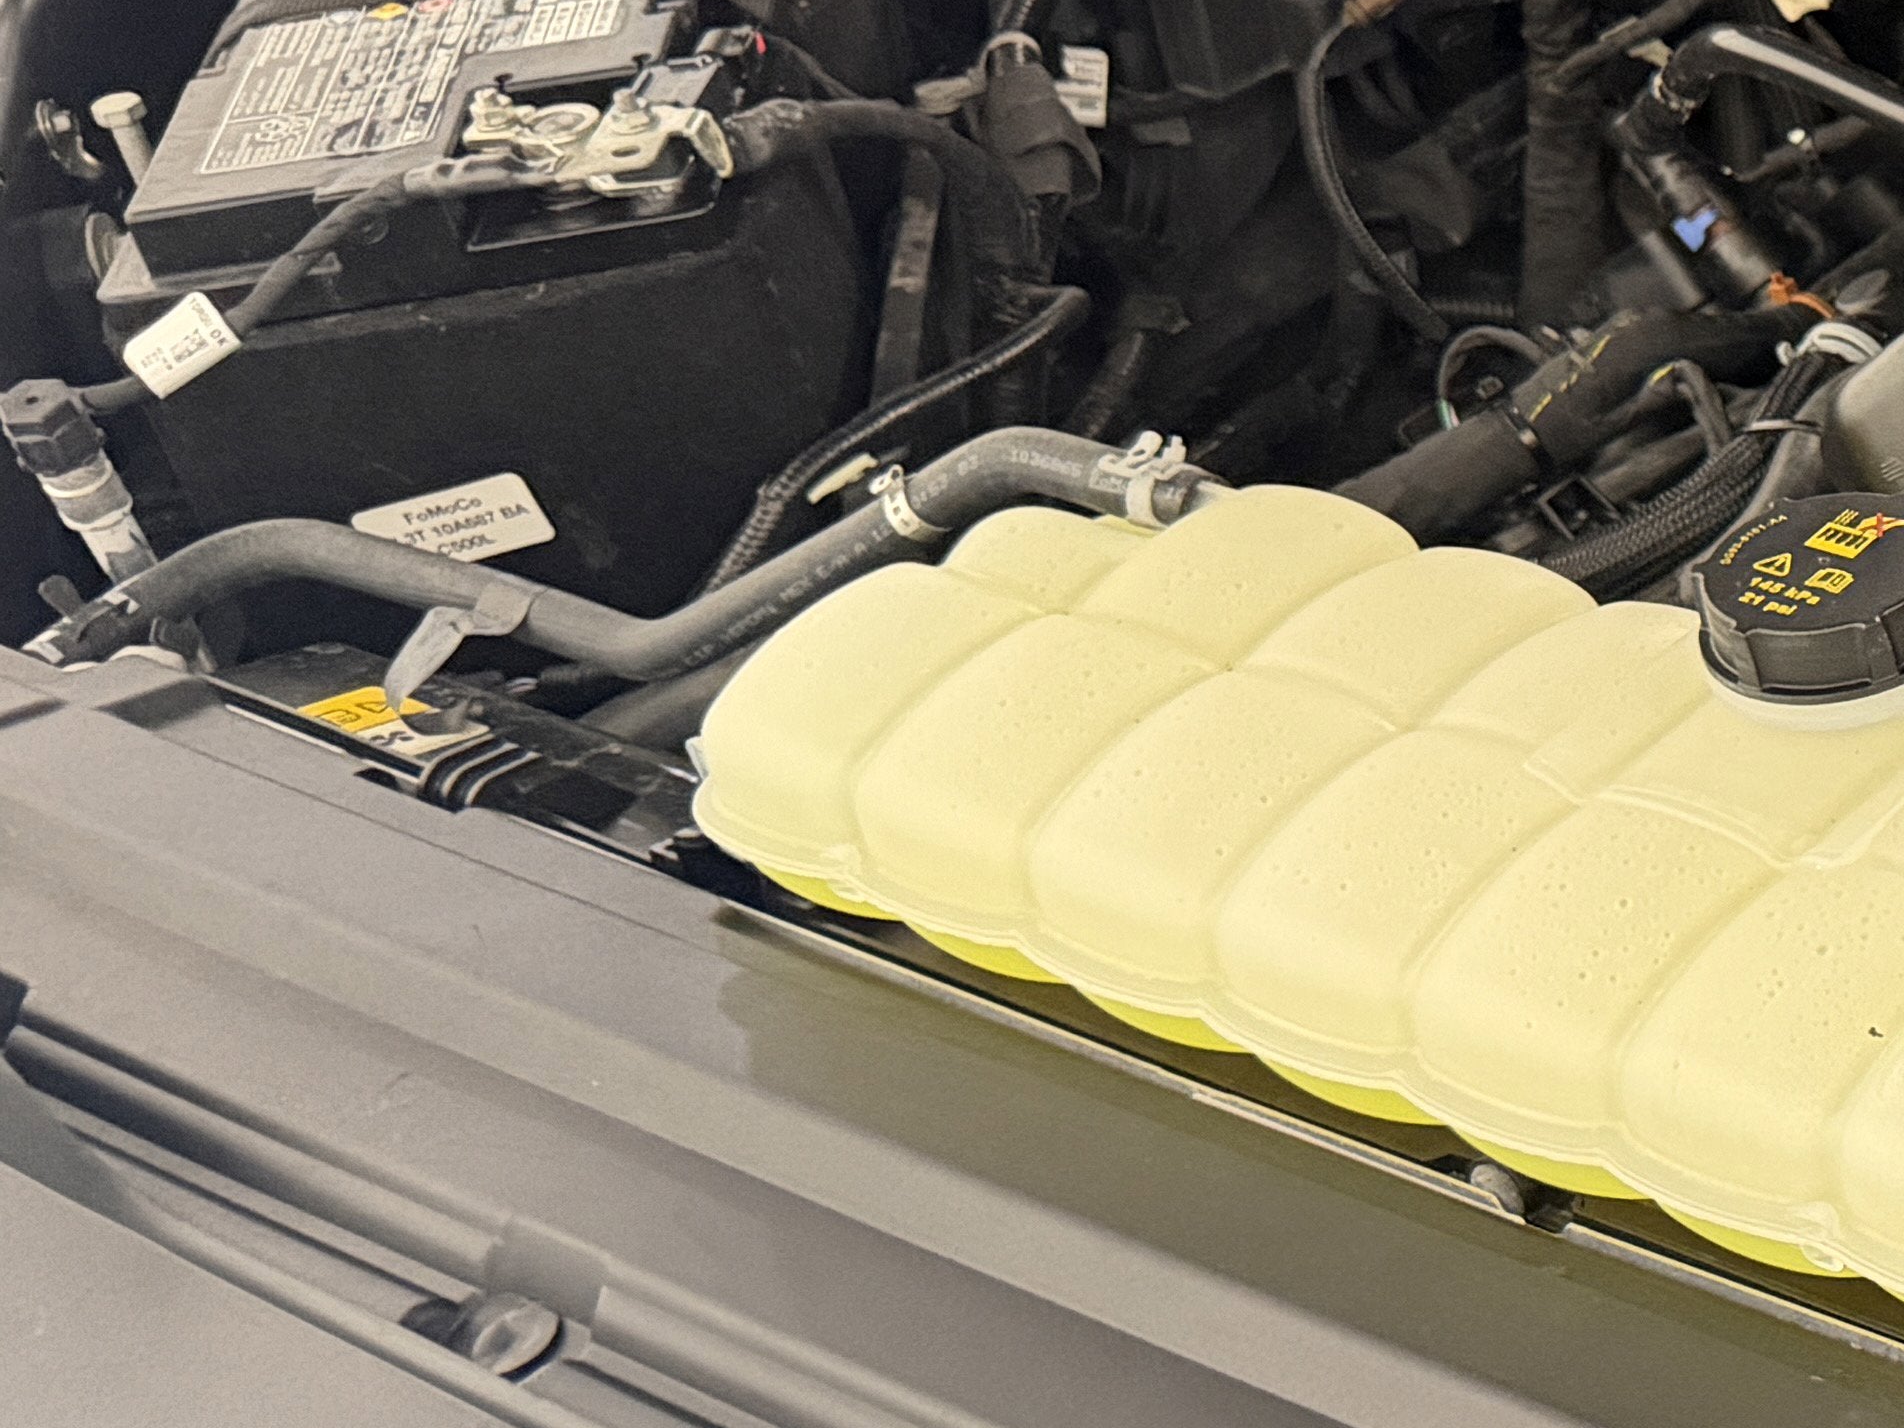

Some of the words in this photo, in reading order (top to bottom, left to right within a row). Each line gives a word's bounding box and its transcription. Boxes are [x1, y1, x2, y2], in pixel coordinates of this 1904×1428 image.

[210, 329, 228, 347] OK
[402, 497, 482, 525] FoMoCo
[1738, 591, 1766, 606] 21
[1762, 601, 1798, 616] psi
[1749, 576, 1786, 594] 145
[1784, 587, 1821, 605] kPa
